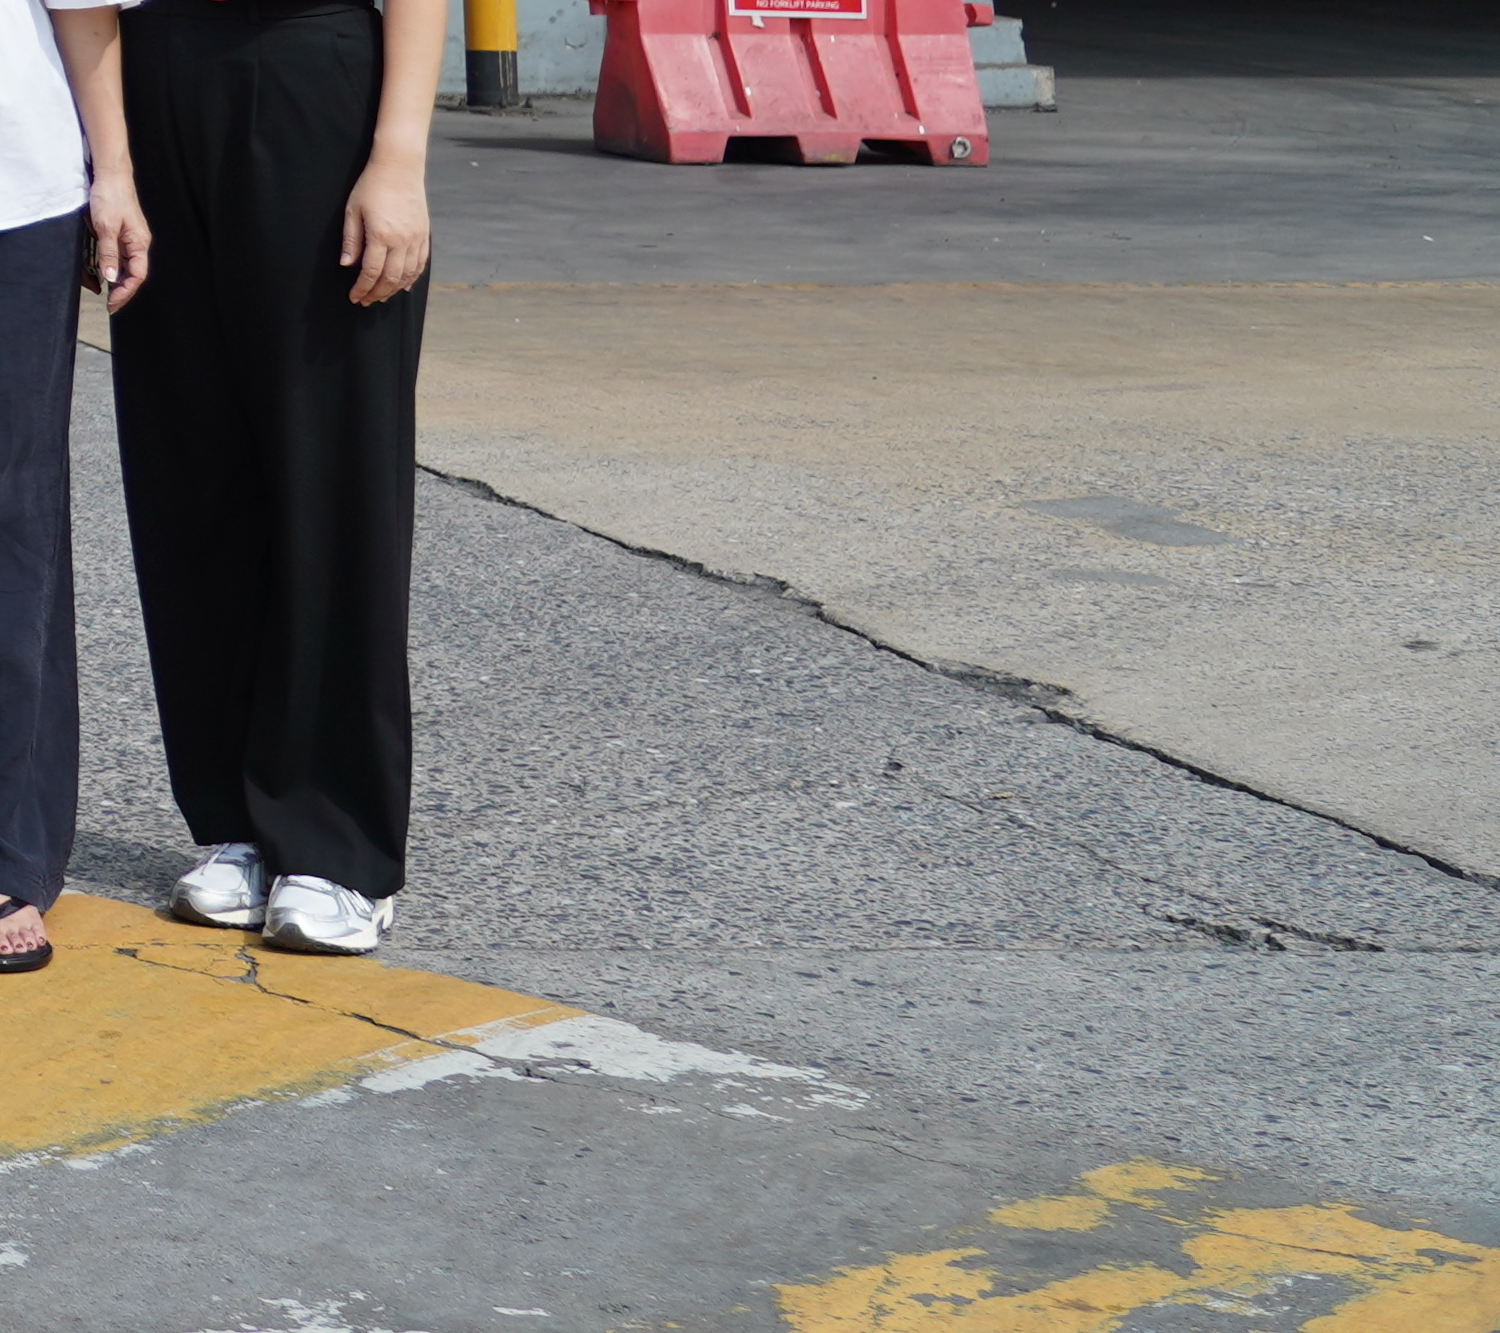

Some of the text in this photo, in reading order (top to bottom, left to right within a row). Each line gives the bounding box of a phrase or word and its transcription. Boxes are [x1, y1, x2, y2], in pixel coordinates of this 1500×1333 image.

[755, 0, 840, 10] NO FORKLIFT PARKING
